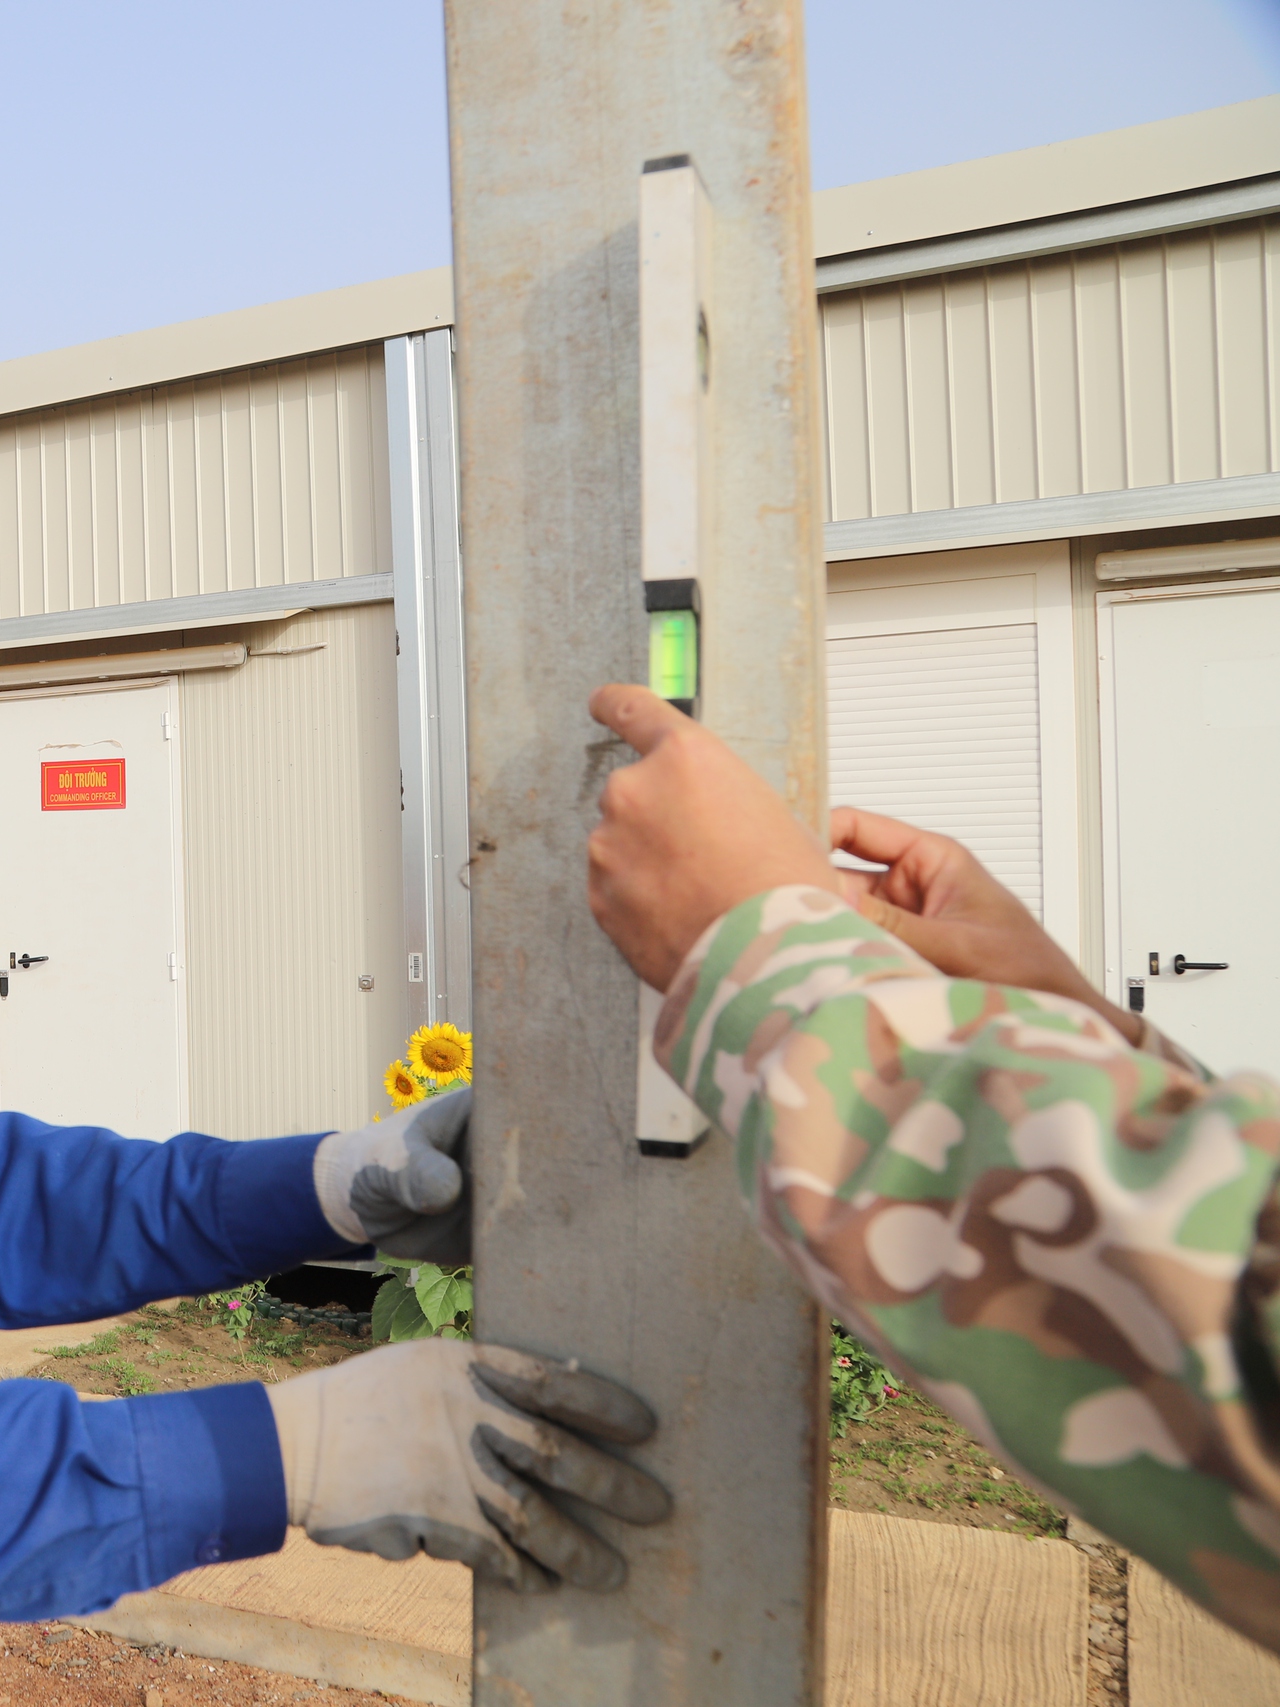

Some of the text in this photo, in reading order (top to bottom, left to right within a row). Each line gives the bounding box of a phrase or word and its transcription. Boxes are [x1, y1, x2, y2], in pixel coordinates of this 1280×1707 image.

[59, 767, 107, 791] ĐỘI TRƯỞNG
[50, 792, 116, 802] COMMANDING OFFICER
